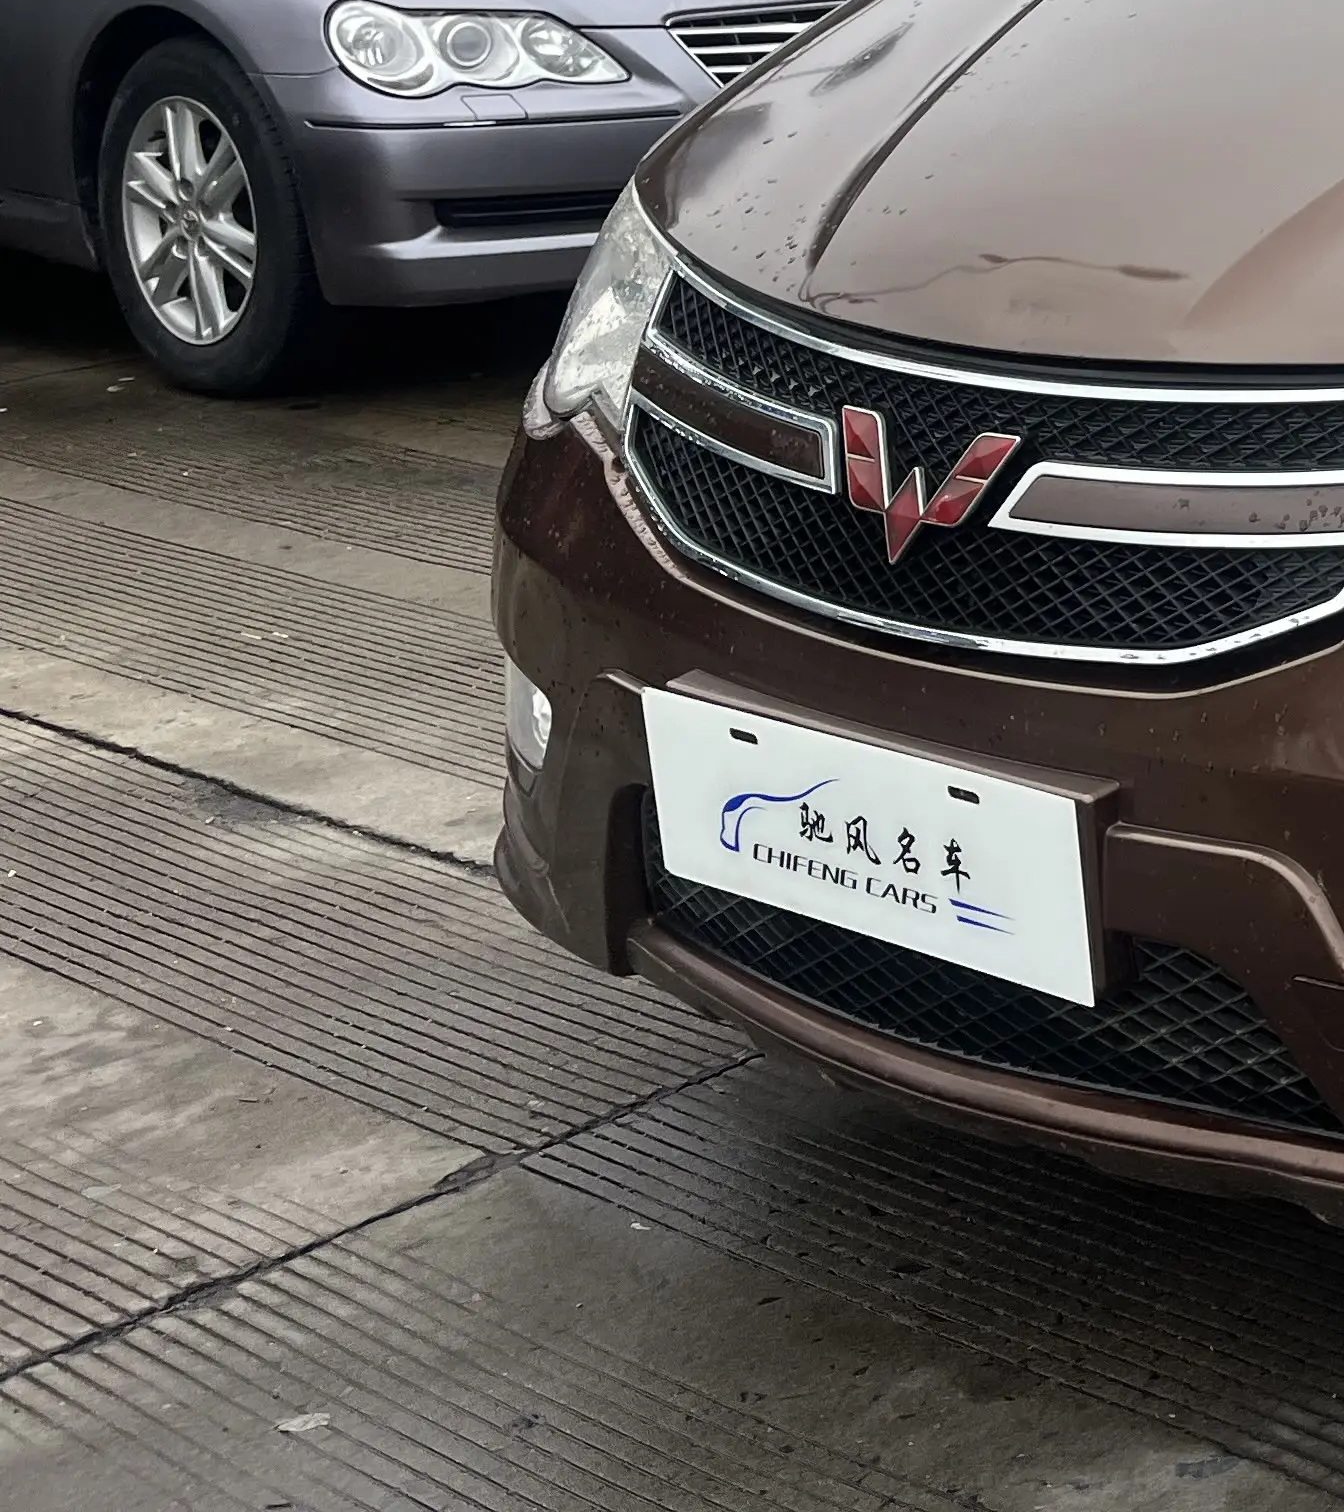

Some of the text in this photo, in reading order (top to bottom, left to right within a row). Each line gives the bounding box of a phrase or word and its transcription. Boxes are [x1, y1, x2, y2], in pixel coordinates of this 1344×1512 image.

[753, 843, 938, 914] CHIFENG CARS
[799, 801, 971, 895] 驰风名车
